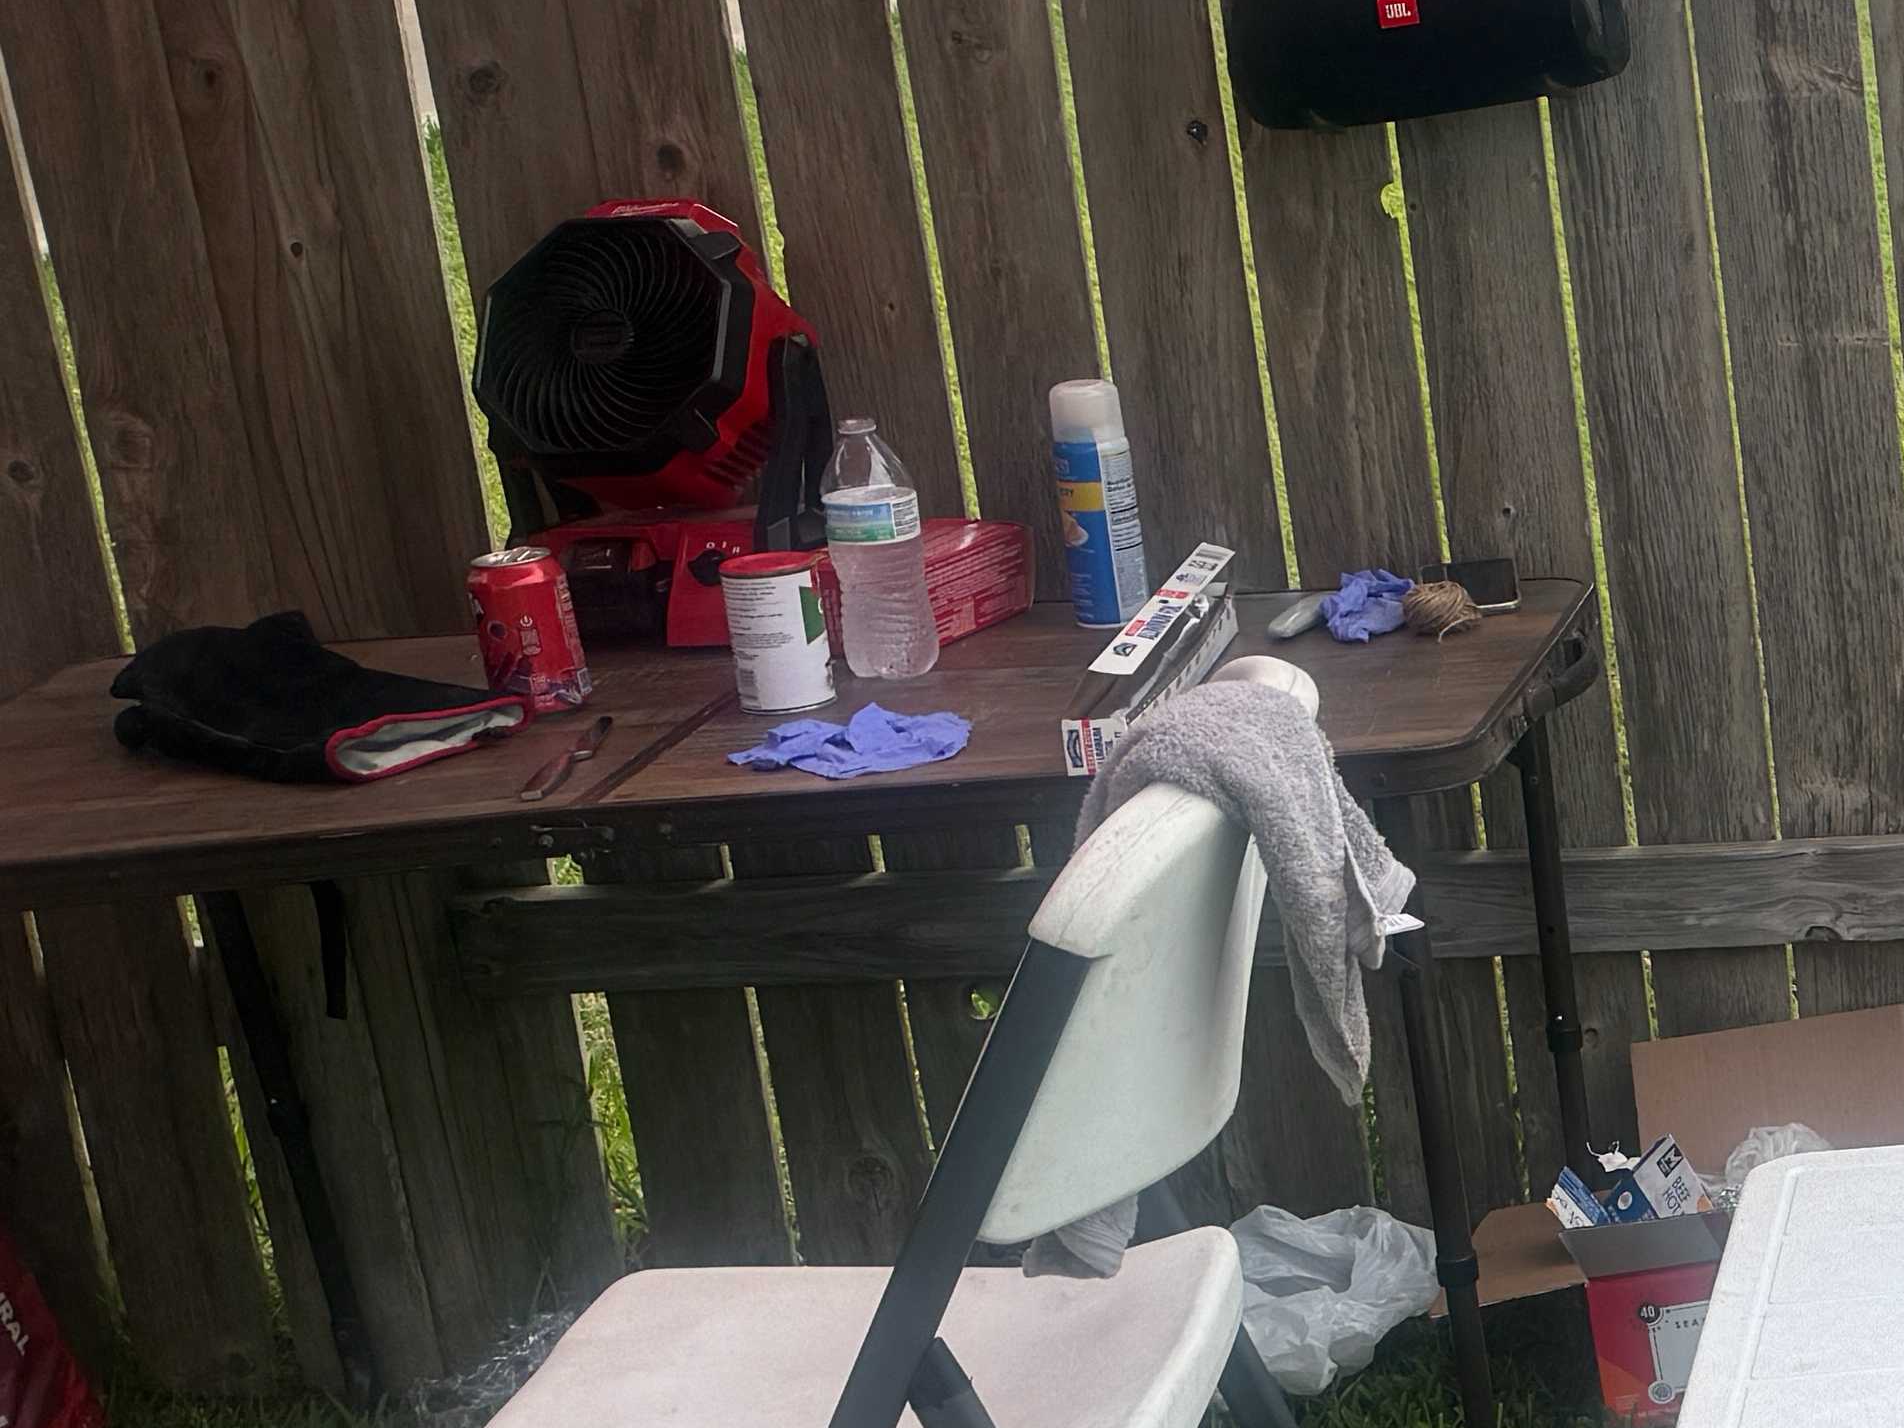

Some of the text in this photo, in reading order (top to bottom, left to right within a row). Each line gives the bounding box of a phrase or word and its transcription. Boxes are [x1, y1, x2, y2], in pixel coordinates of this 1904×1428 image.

[1385, 2, 1411, 19] JBL
[1639, 1305, 1655, 1319] 40
[0, 1292, 29, 1356] RAL
[1675, 1318, 1706, 1330] SEA
